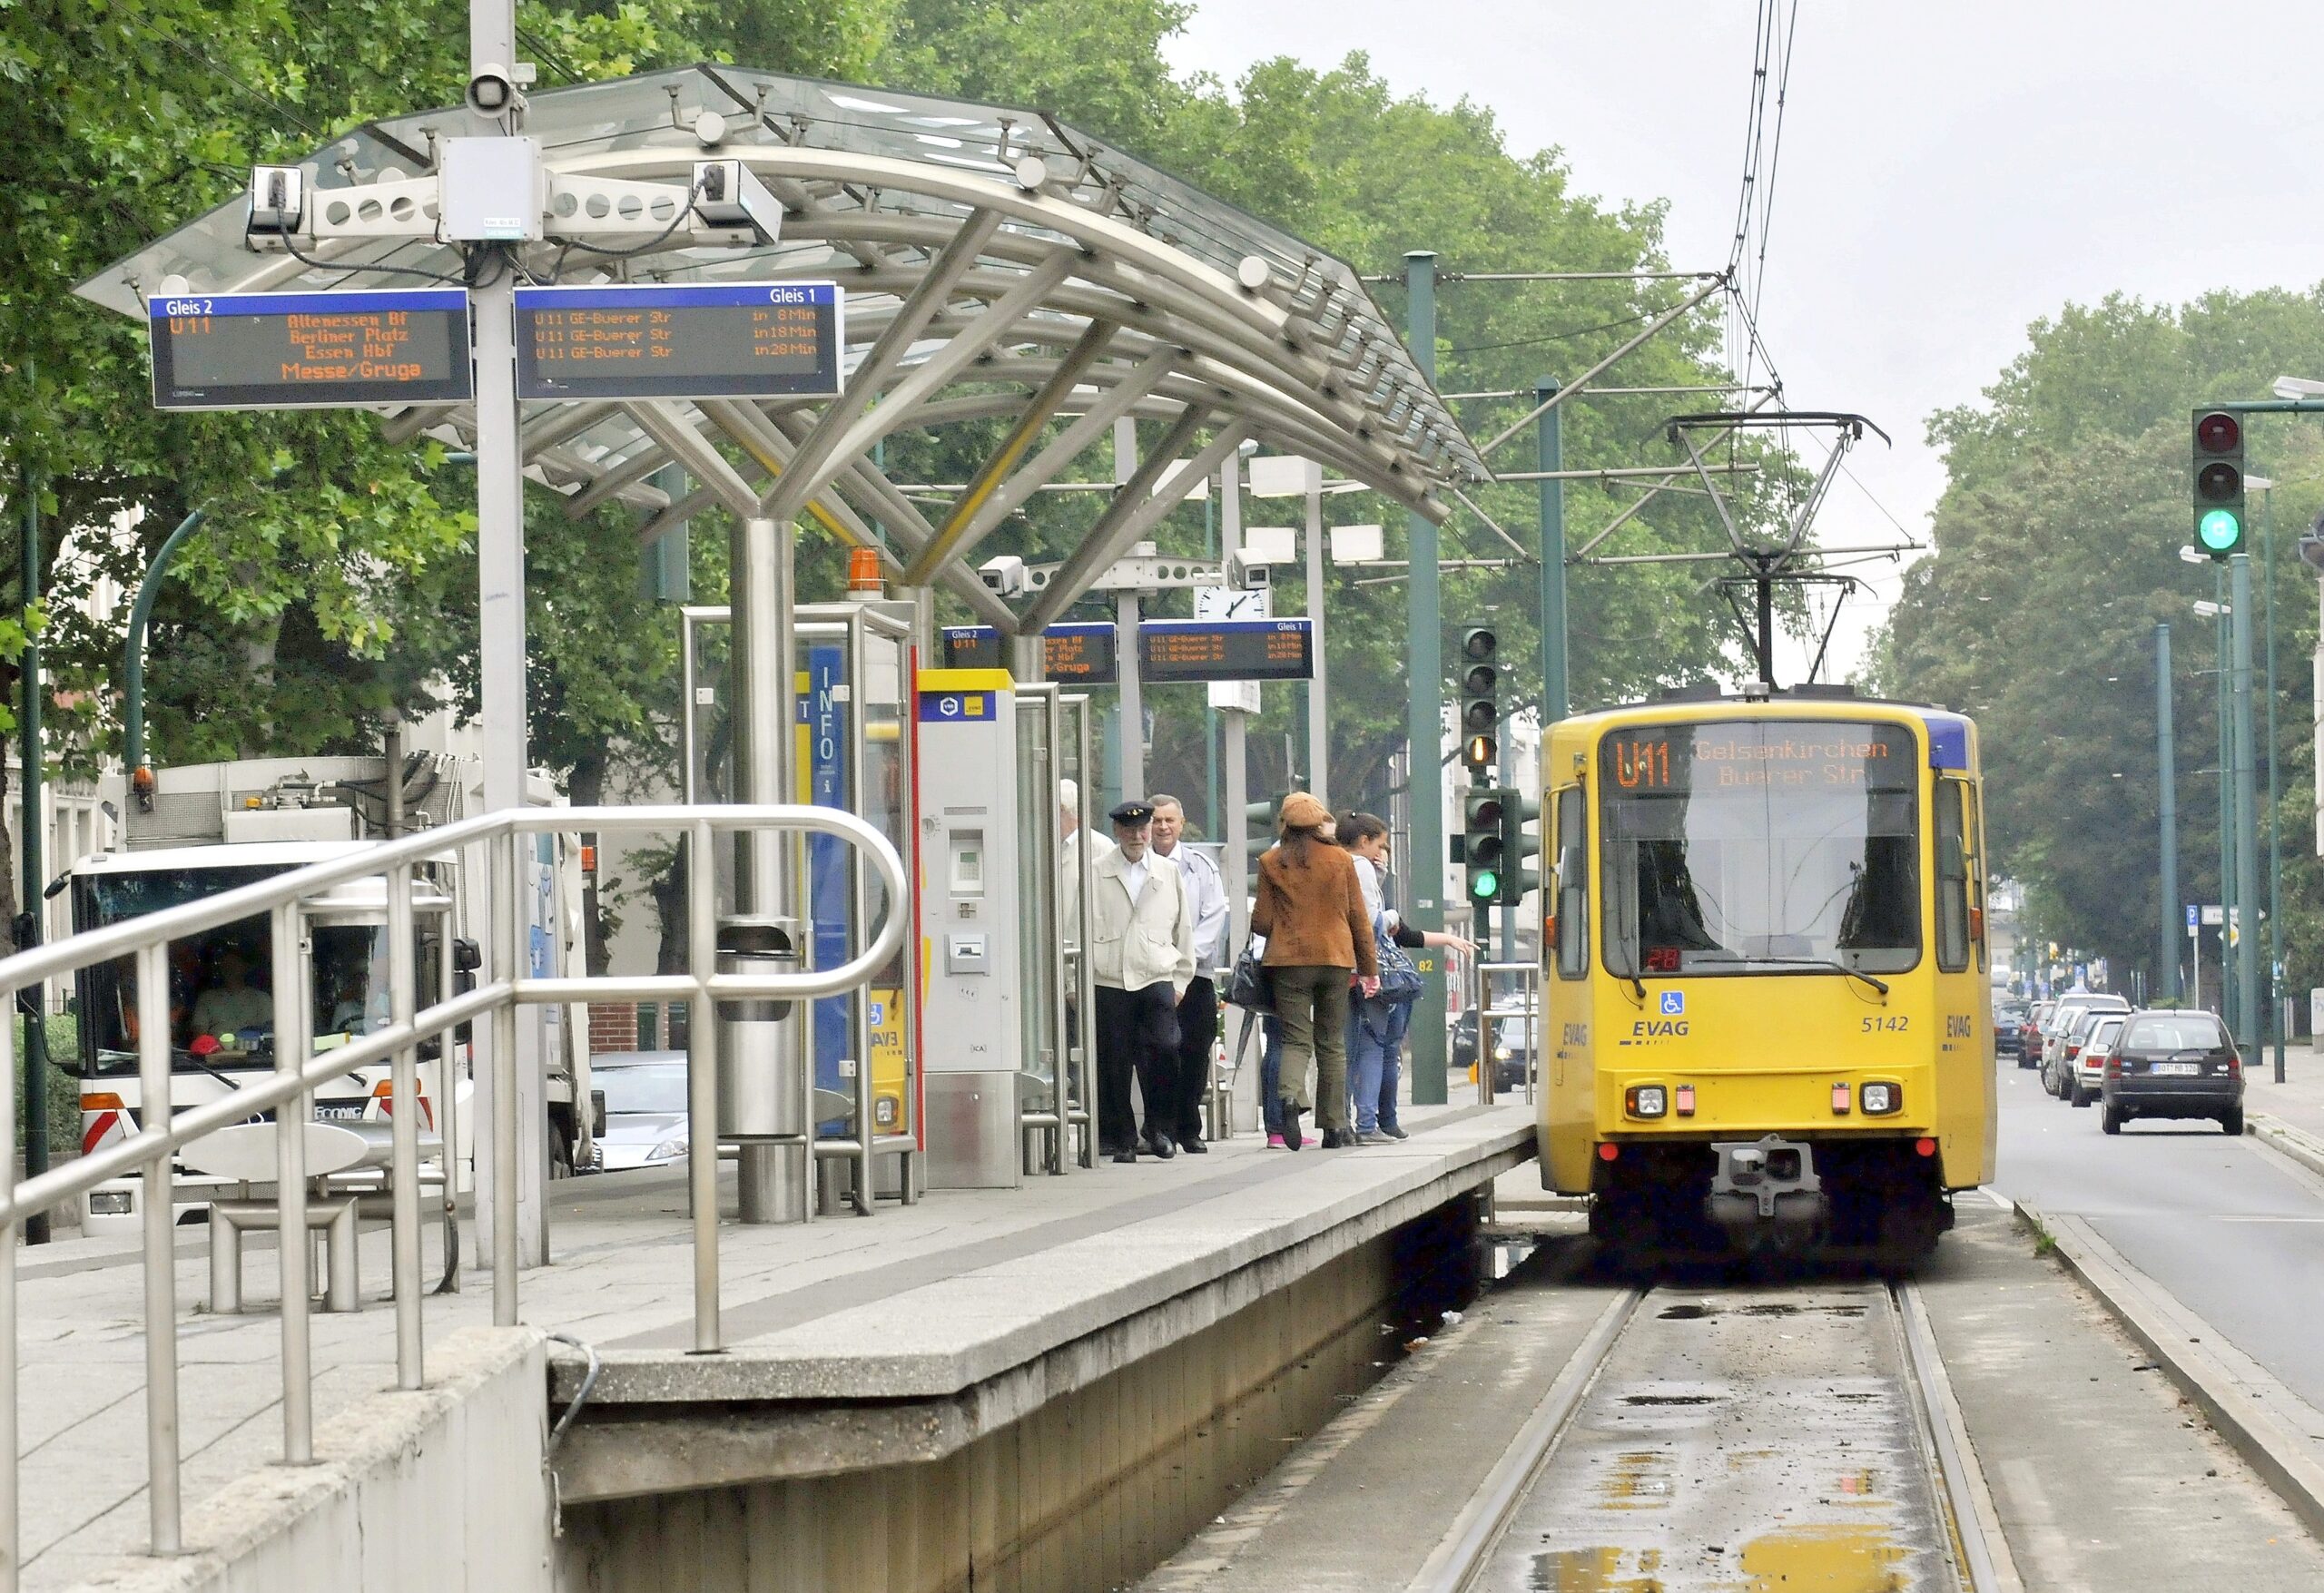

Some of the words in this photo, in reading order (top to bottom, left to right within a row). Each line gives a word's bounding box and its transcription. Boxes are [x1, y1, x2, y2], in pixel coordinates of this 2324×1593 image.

[770, 288, 804, 303] Gleis
[809, 288, 815, 302] 1
[166, 300, 201, 316] Gleis
[204, 300, 212, 314] 2
[288, 314, 379, 329] Altenessen
[389, 311, 408, 326] Bf
[570, 312, 641, 324] GE-Buerer
[650, 310, 670, 323] Str
[170, 317, 211, 335] U11
[290, 329, 355, 344] Berliner
[365, 327, 409, 342] Platz
[570, 329, 642, 341] GE-Buerer
[651, 328, 671, 340] Str
[305, 345, 354, 359] Essen
[363, 343, 394, 358] Hbf
[571, 346, 642, 359] GE-Buerer
[651, 345, 672, 358] Str
[281, 360, 421, 381] Messe/Gruga
[1278, 622, 1296, 631] Gleis
[952, 630, 970, 639] Gleis
[972, 630, 977, 638] 2
[953, 639, 977, 649] U11
[819, 667, 834, 760] INFO
[1617, 741, 1669, 788] U11
[1696, 739, 1888, 761] Gelsenkirchen
[2189, 909, 2195, 923] P
[1419, 959, 1433, 972] 82
[1633, 1021, 1689, 1036] EVAG
[1861, 1017, 1908, 1032] 5142
[1946, 1015, 1970, 1037] EVAG
[1563, 1023, 1587, 1046] EVAG
